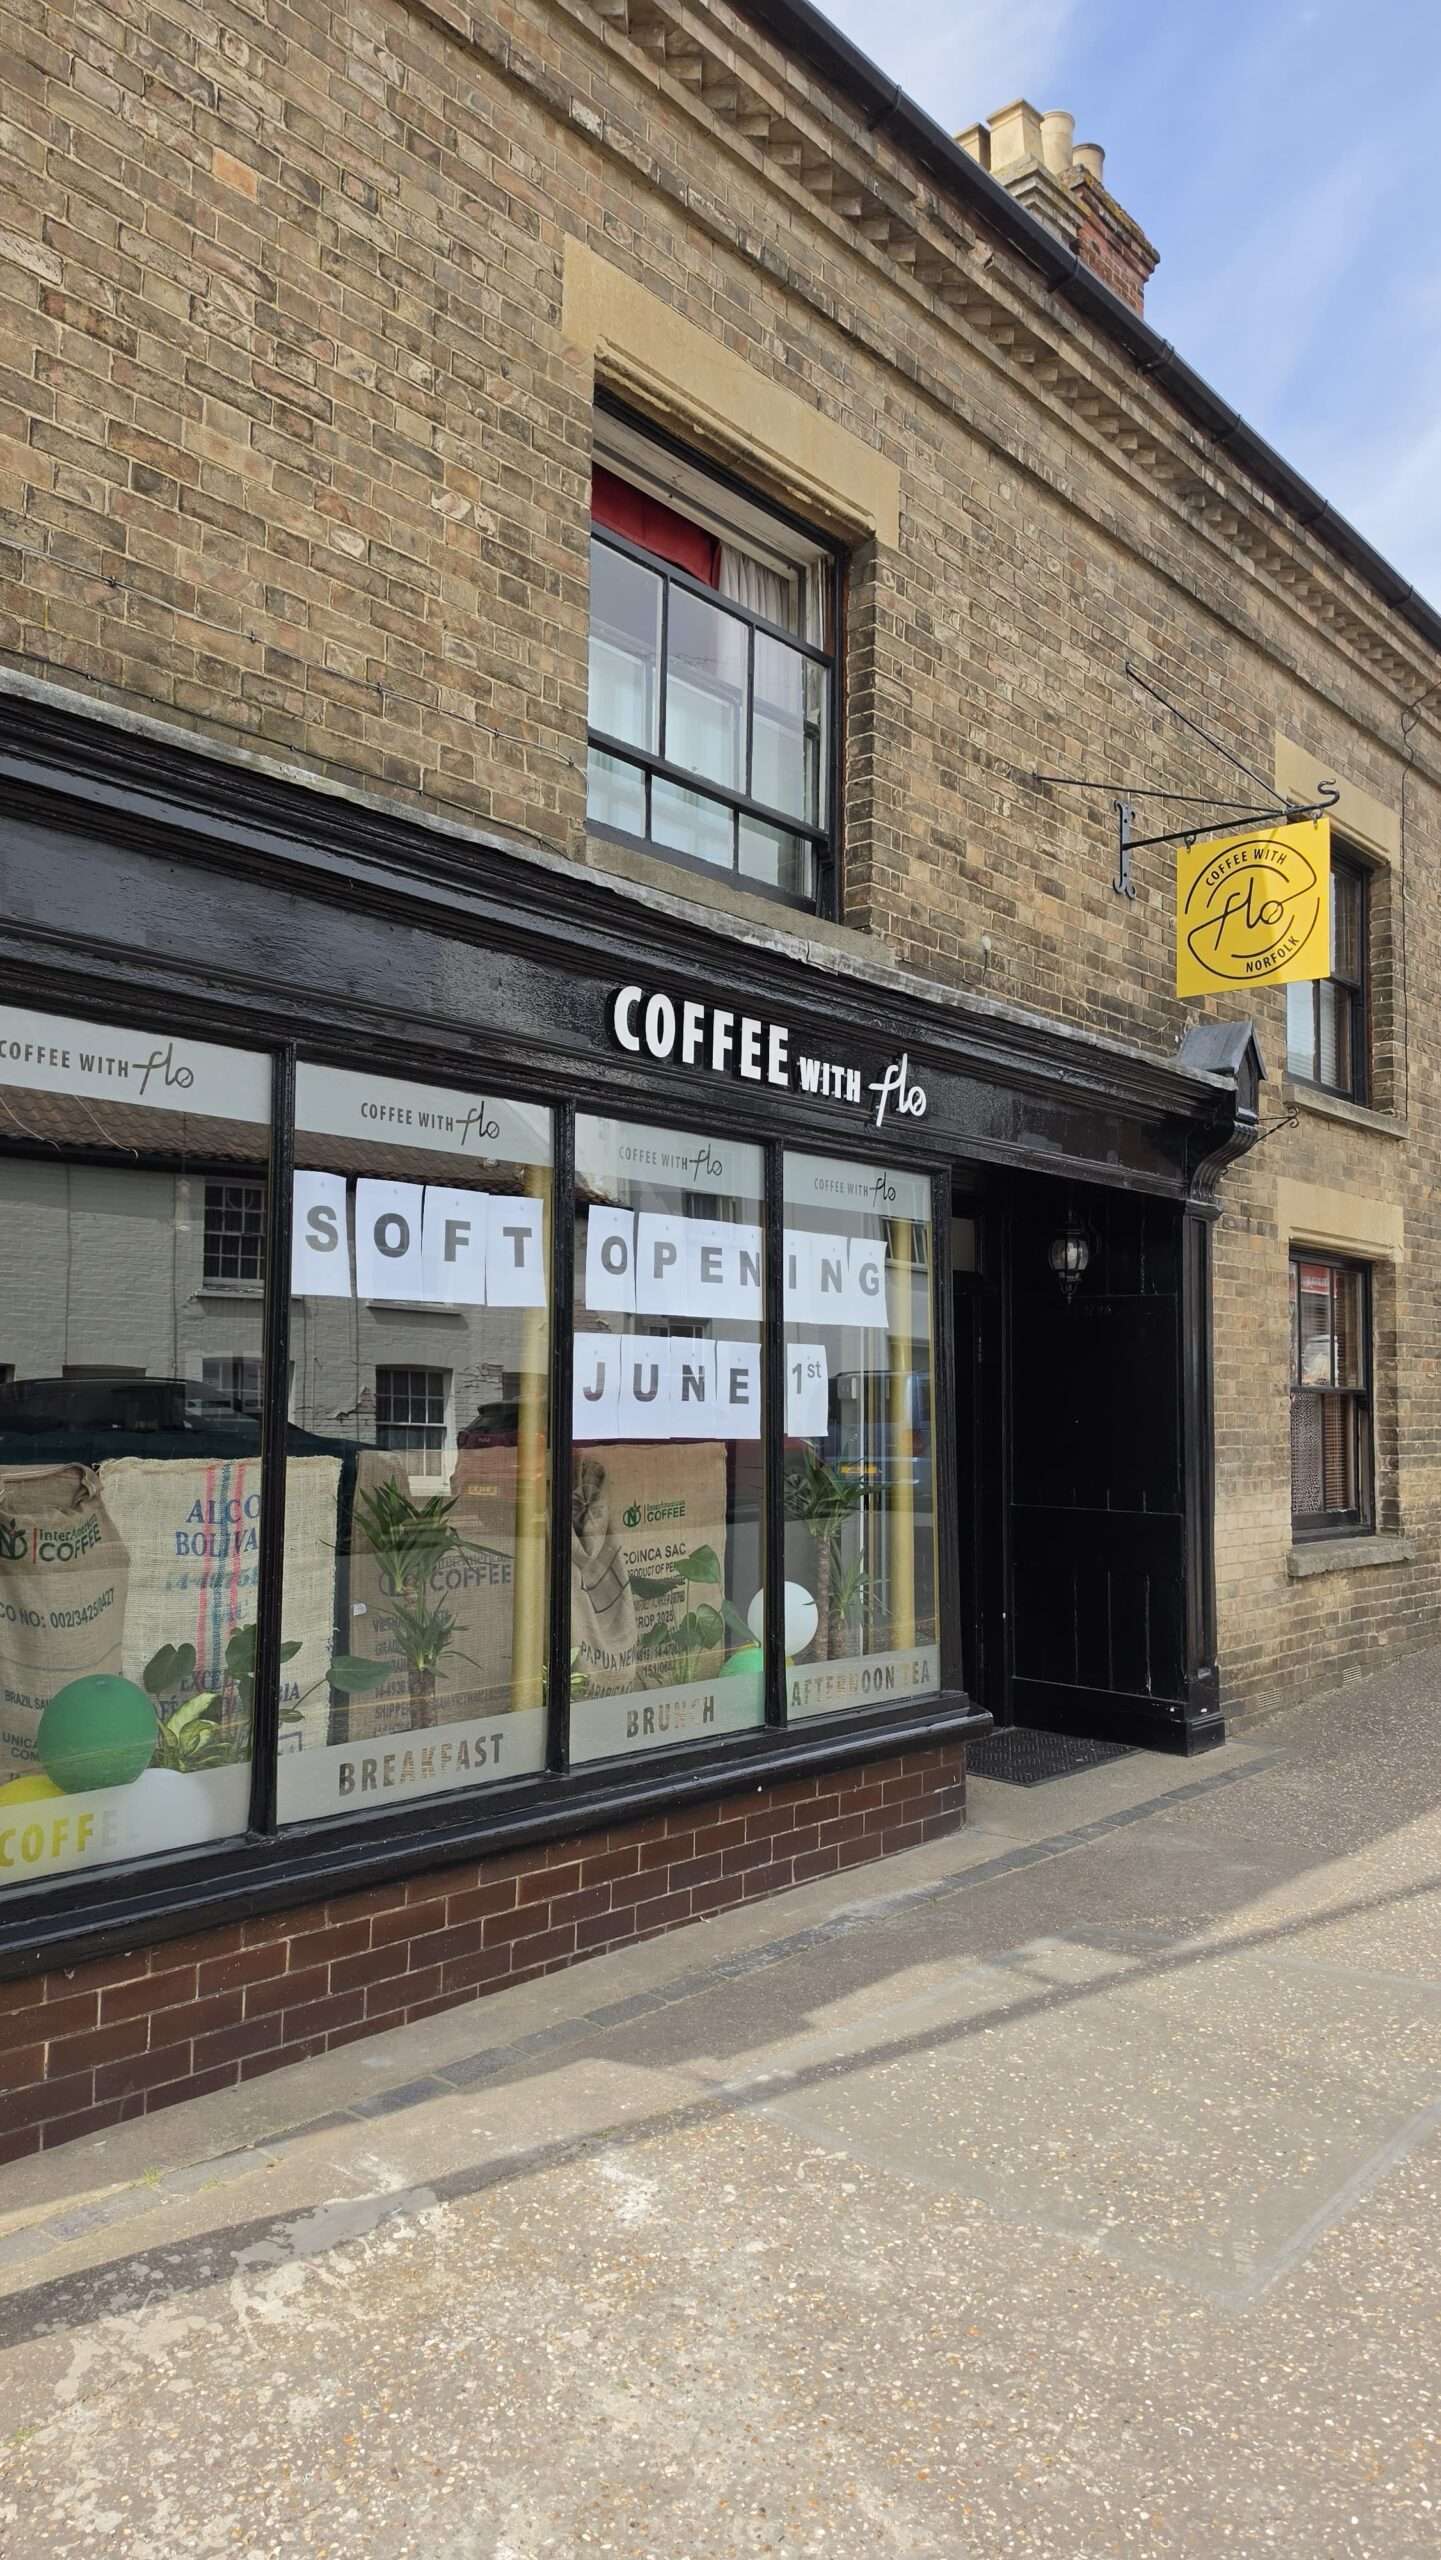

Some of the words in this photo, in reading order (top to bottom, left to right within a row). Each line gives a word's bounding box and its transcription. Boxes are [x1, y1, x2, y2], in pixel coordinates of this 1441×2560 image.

[1205, 850, 1248, 888] COFFEE
[1253, 848, 1288, 866] WITH
[1245, 935, 1300, 974] NORFOLK
[0, 1040, 71, 1069] COFFEE
[79, 1053, 129, 1078] WITH
[132, 1042, 194, 1096] flo
[612, 985, 789, 1087] COFFEE
[799, 1056, 861, 1103] WITH
[868, 1053, 927, 1127] flo
[361, 1102, 413, 1125] COFFEE
[418, 1111, 454, 1132] WITH
[455, 1100, 500, 1146] flo
[618, 1146, 657, 1165] COFFEE
[661, 1153, 688, 1170] WITH
[689, 1144, 723, 1182] flo
[814, 1177, 845, 1193] COFFEE
[847, 1183, 868, 1197] WITH
[869, 1171, 896, 1208] flo
[305, 1205, 533, 1269] SOFT
[582, 1361, 750, 1404] JUNE
[790, 1361, 823, 1396] 1st
[646, 1505, 686, 1522] COFFEE
[39, 1524, 102, 1562] COFFEE
[665, 1543, 687, 1558] SAC
[431, 1564, 512, 1592] COFFEE
[20, 1608, 46, 1629] NO:
[581, 1640, 618, 1670] PAPUA
[338, 1733, 504, 1797] BREAKFAST
[0, 1810, 138, 1868] COFFE
